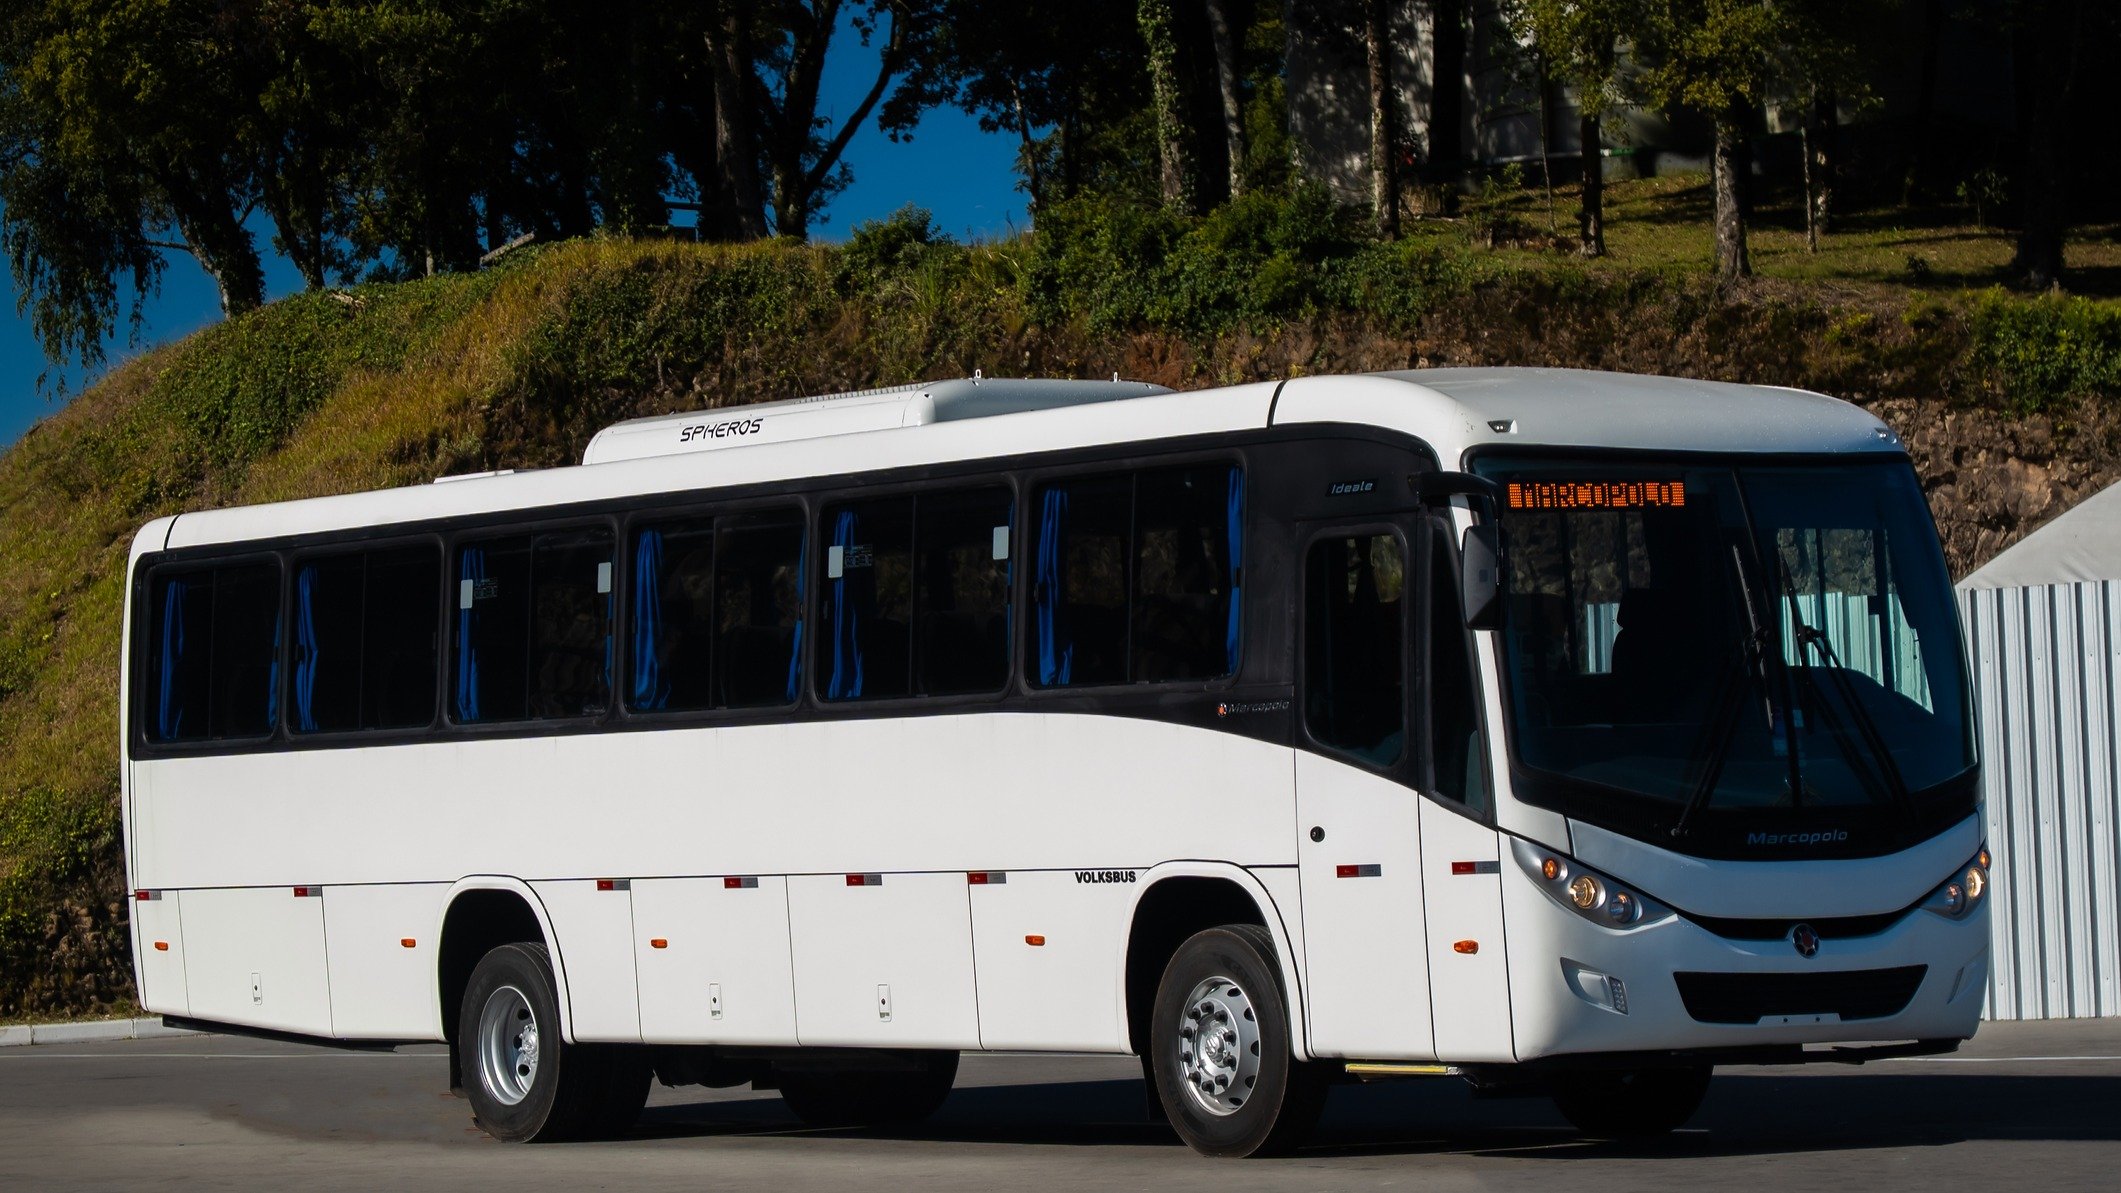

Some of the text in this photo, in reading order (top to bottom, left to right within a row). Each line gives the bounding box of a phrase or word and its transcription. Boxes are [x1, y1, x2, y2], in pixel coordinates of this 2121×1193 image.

[680, 418, 764, 442] SPHEROS
[1331, 481, 1373, 494] Ideale
[1517, 483, 1677, 508] MARCOPOLO
[1228, 700, 1290, 713] Marcopolo
[1747, 829, 1848, 845] Marcopolo
[1075, 871, 1136, 883] VOLKSBUS
